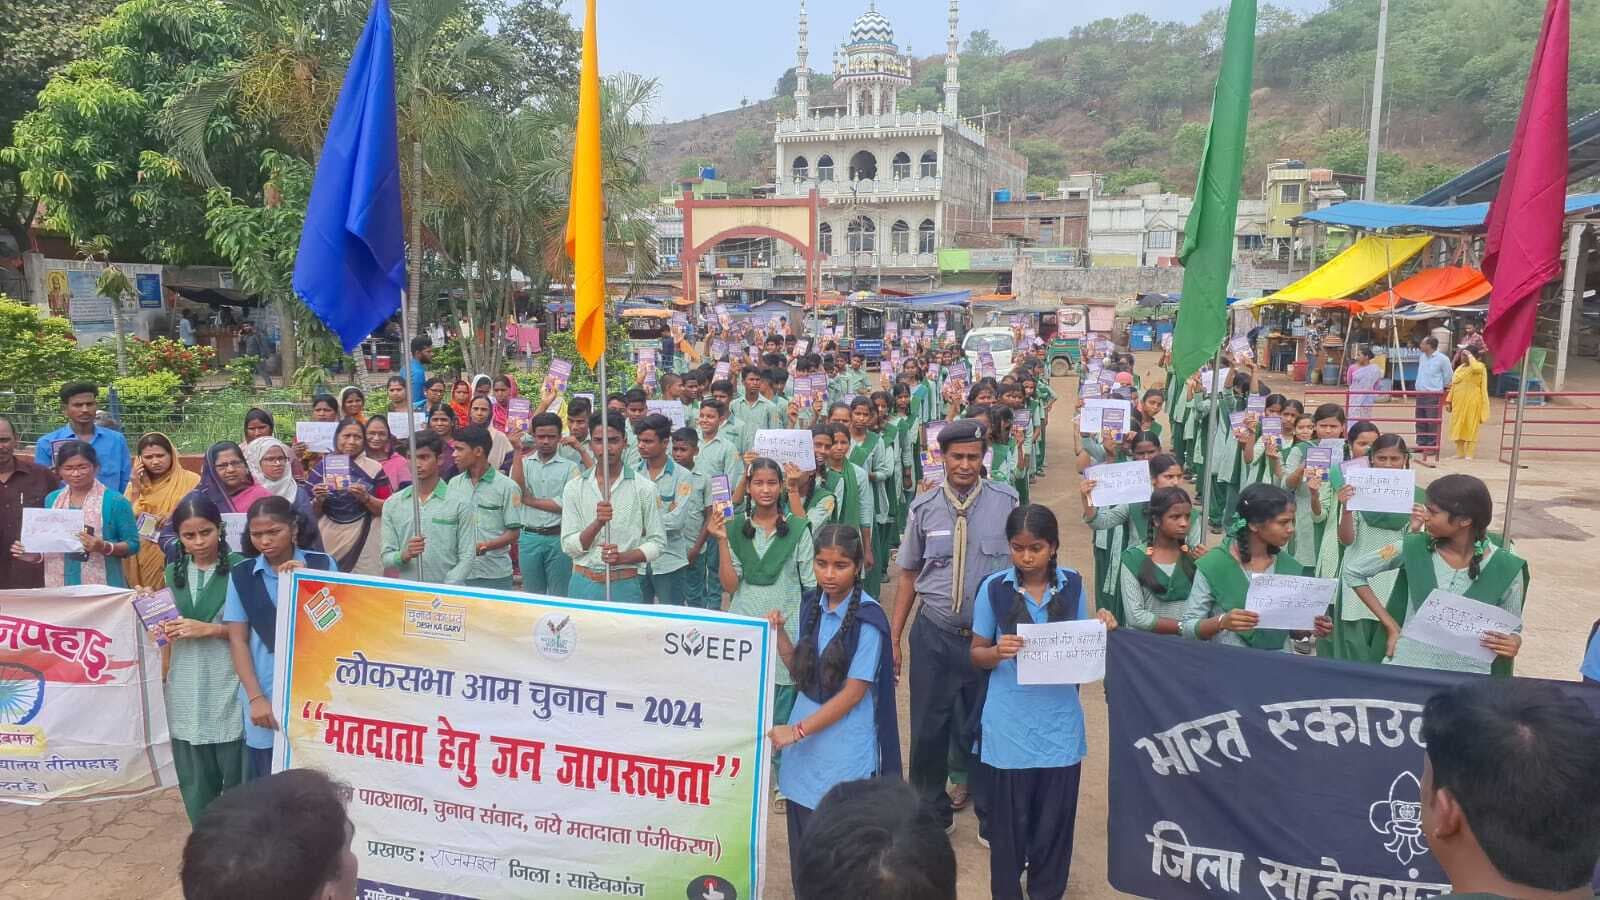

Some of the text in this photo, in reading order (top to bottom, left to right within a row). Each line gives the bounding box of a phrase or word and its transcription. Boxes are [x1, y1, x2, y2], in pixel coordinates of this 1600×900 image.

[0, 616, 112, 679] नपहाड़
[416, 622, 432, 630] DESH
[444, 625, 461, 633] GARV
[336, 652, 454, 698] लोकसभा
[461, 675, 521, 706] आम
[528, 681, 608, 719] चुनाव
[644, 695, 703, 729] 2024
[46, 755, 119, 772] तीनपहाड़
[437, 716, 480, 788] हेतु
[490, 734, 545, 782] जन
[1134, 710, 1252, 776] भारत
[359, 788, 427, 816] पाठशाला,
[433, 799, 474, 825] चुनाव
[479, 802, 528, 833] संवाद,
[534, 813, 562, 836] नये
[566, 820, 631, 846] मतदाता
[635, 825, 722, 863] पंजीकरण)
[368, 840, 416, 863] प्रखण्ड
[508, 858, 549, 884] जिला
[1145, 820, 1454, 900] जिला साहेबगं
